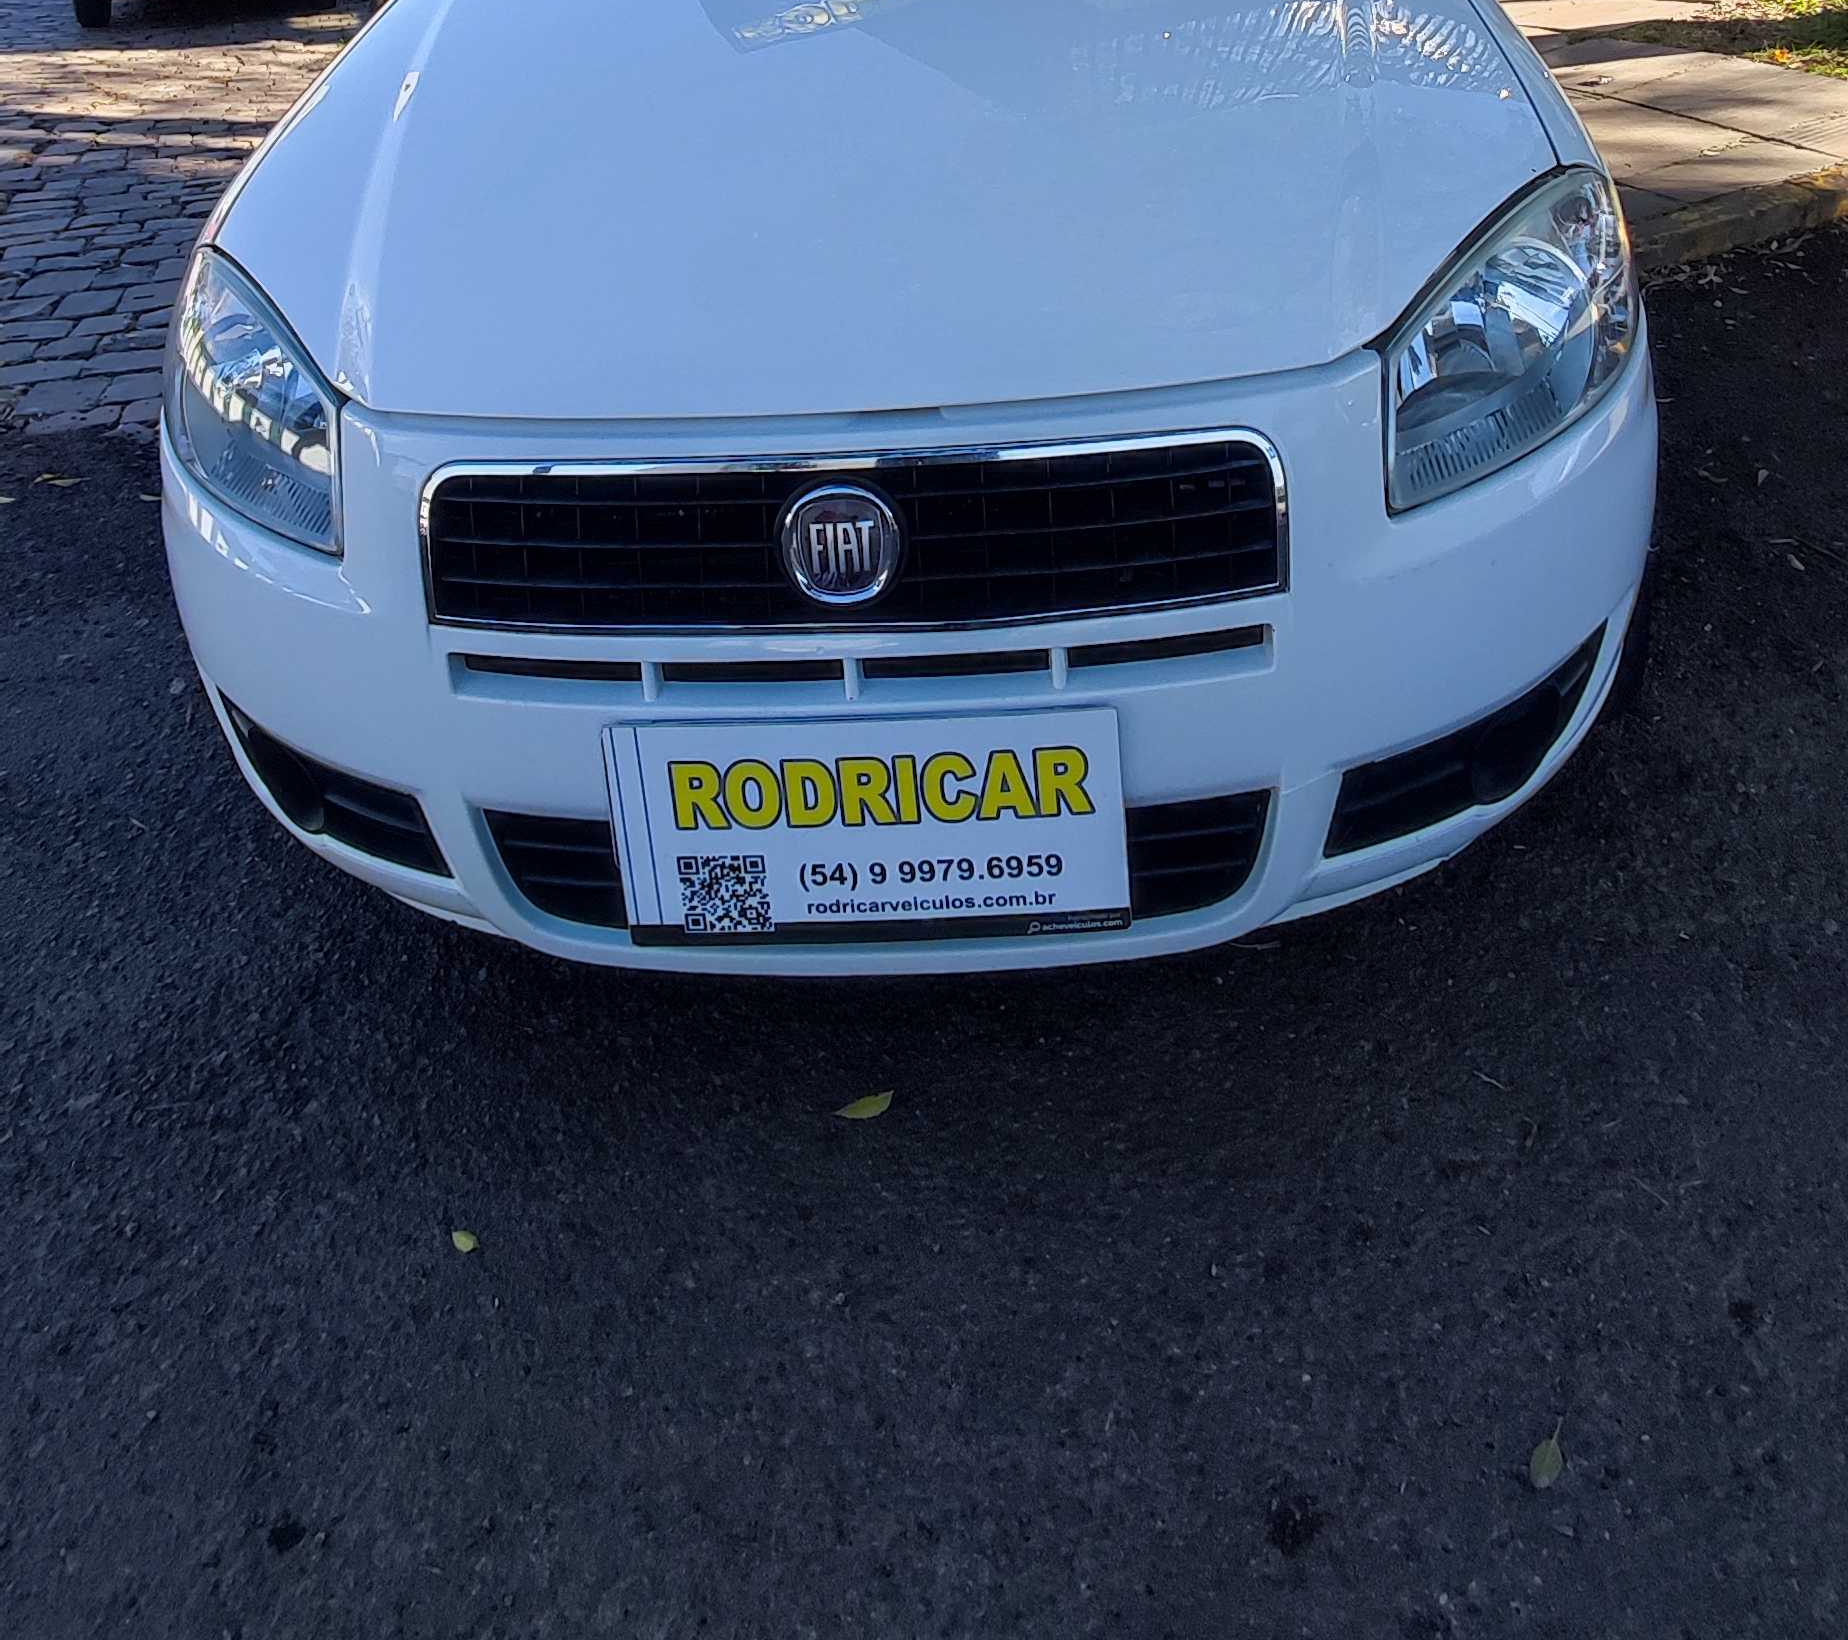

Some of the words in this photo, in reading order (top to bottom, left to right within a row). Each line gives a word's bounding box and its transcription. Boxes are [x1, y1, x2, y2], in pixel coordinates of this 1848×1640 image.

[809, 520, 875, 574] FIAT
[667, 745, 1096, 830] RODRICAR
[799, 862, 858, 892] (54)
[869, 862, 887, 884] 9
[899, 853, 1063, 883] 9979.6959
[807, 891, 1056, 914] rodricarveiculos.com.br
